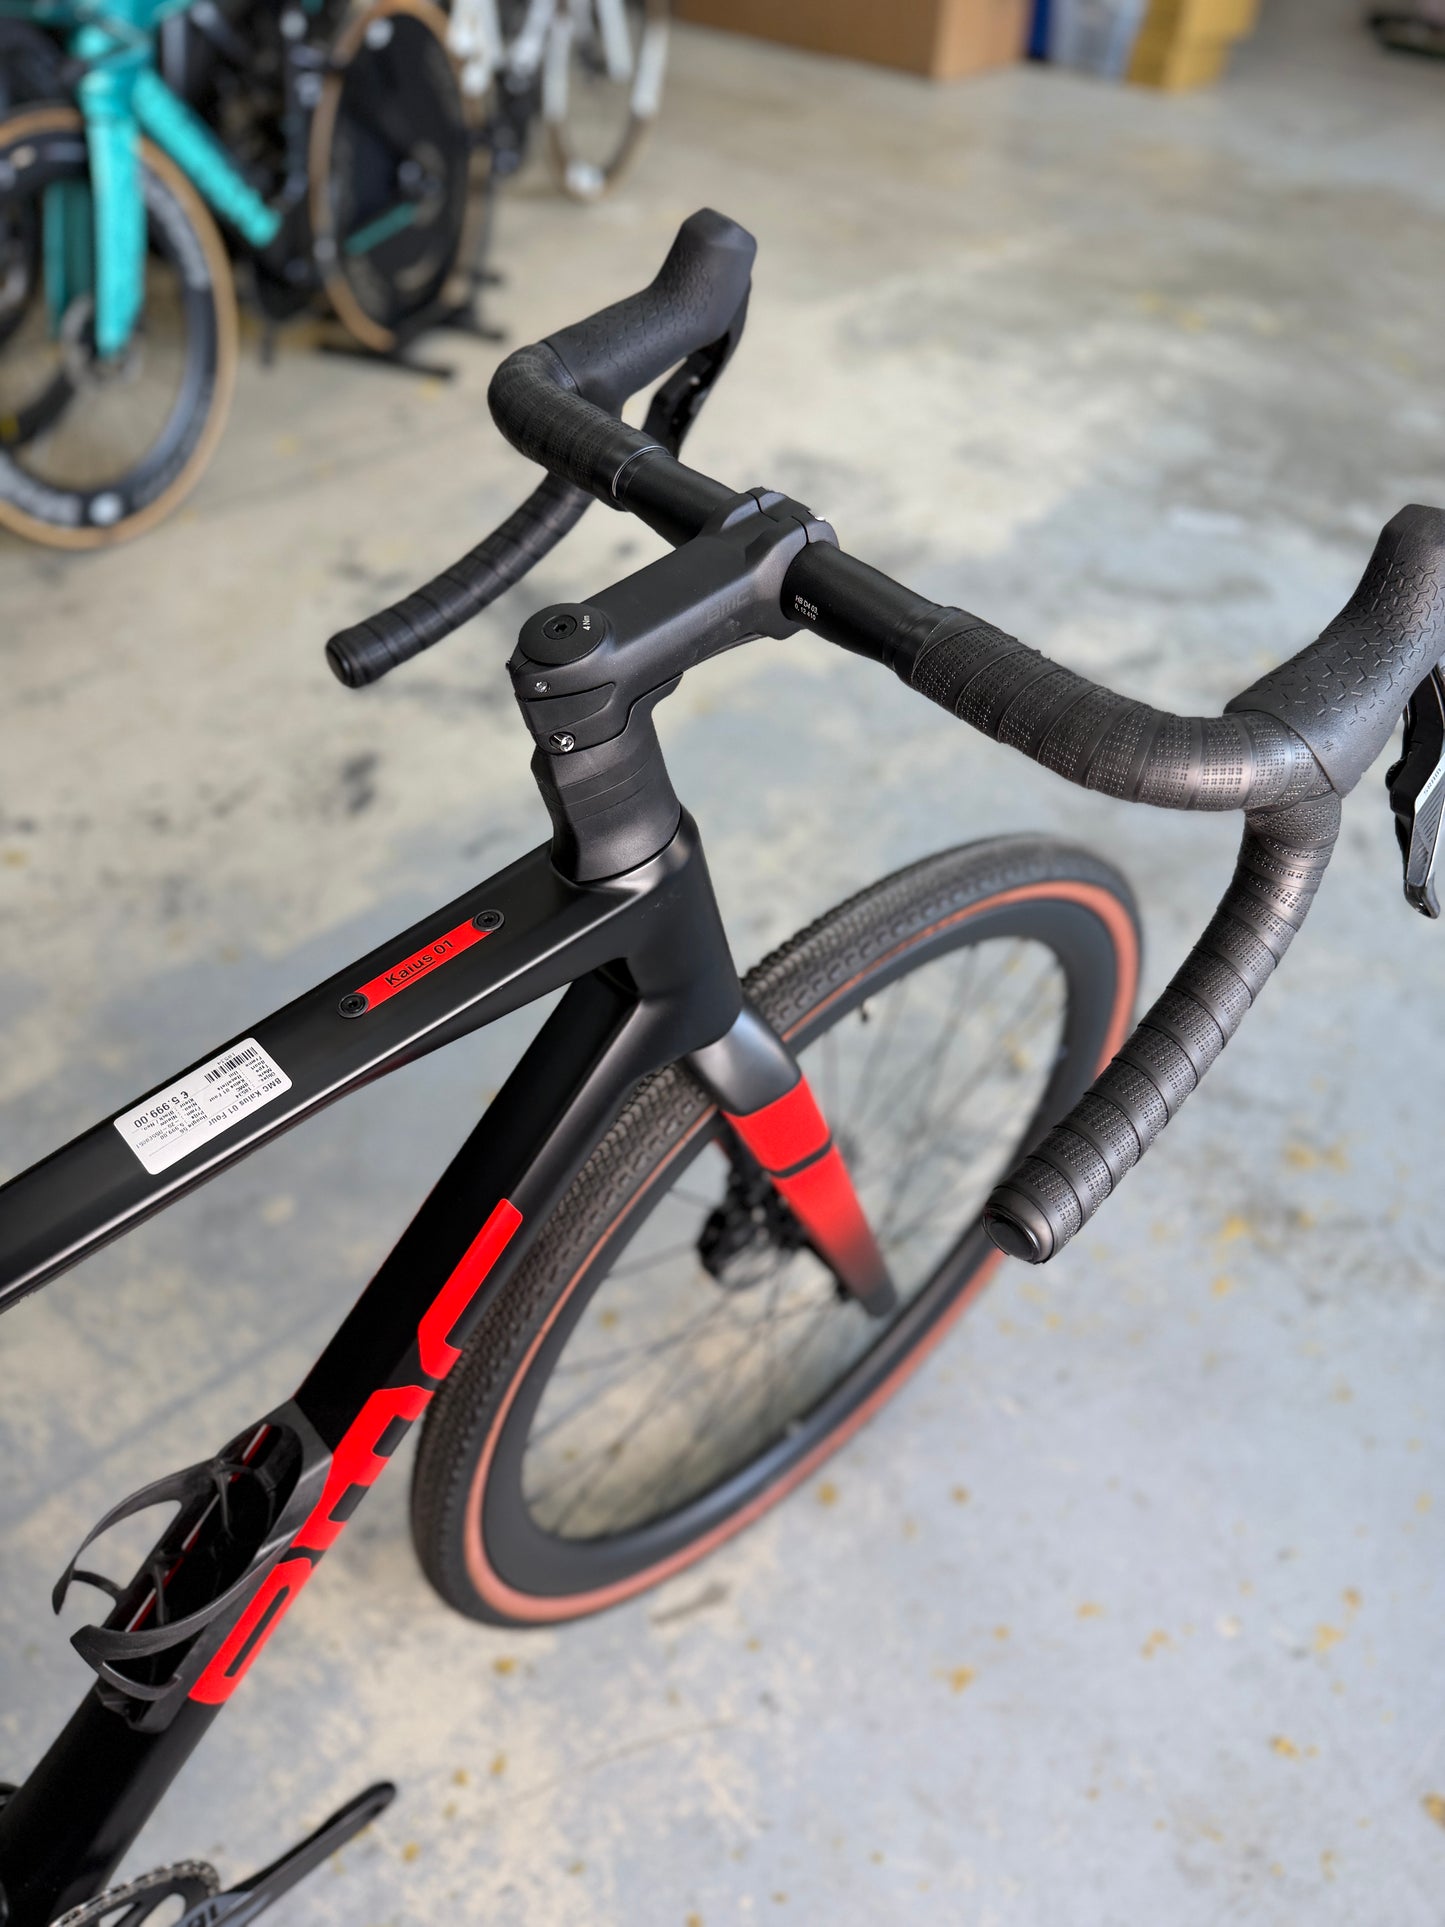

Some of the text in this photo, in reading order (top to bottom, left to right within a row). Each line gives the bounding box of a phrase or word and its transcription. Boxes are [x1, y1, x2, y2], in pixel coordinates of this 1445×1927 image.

[384, 940, 454, 985] Kaius 01
[132, 1089, 189, 1128] € 5.999,00
[206, 1077, 282, 1127] BMC Kaius 01 Four
